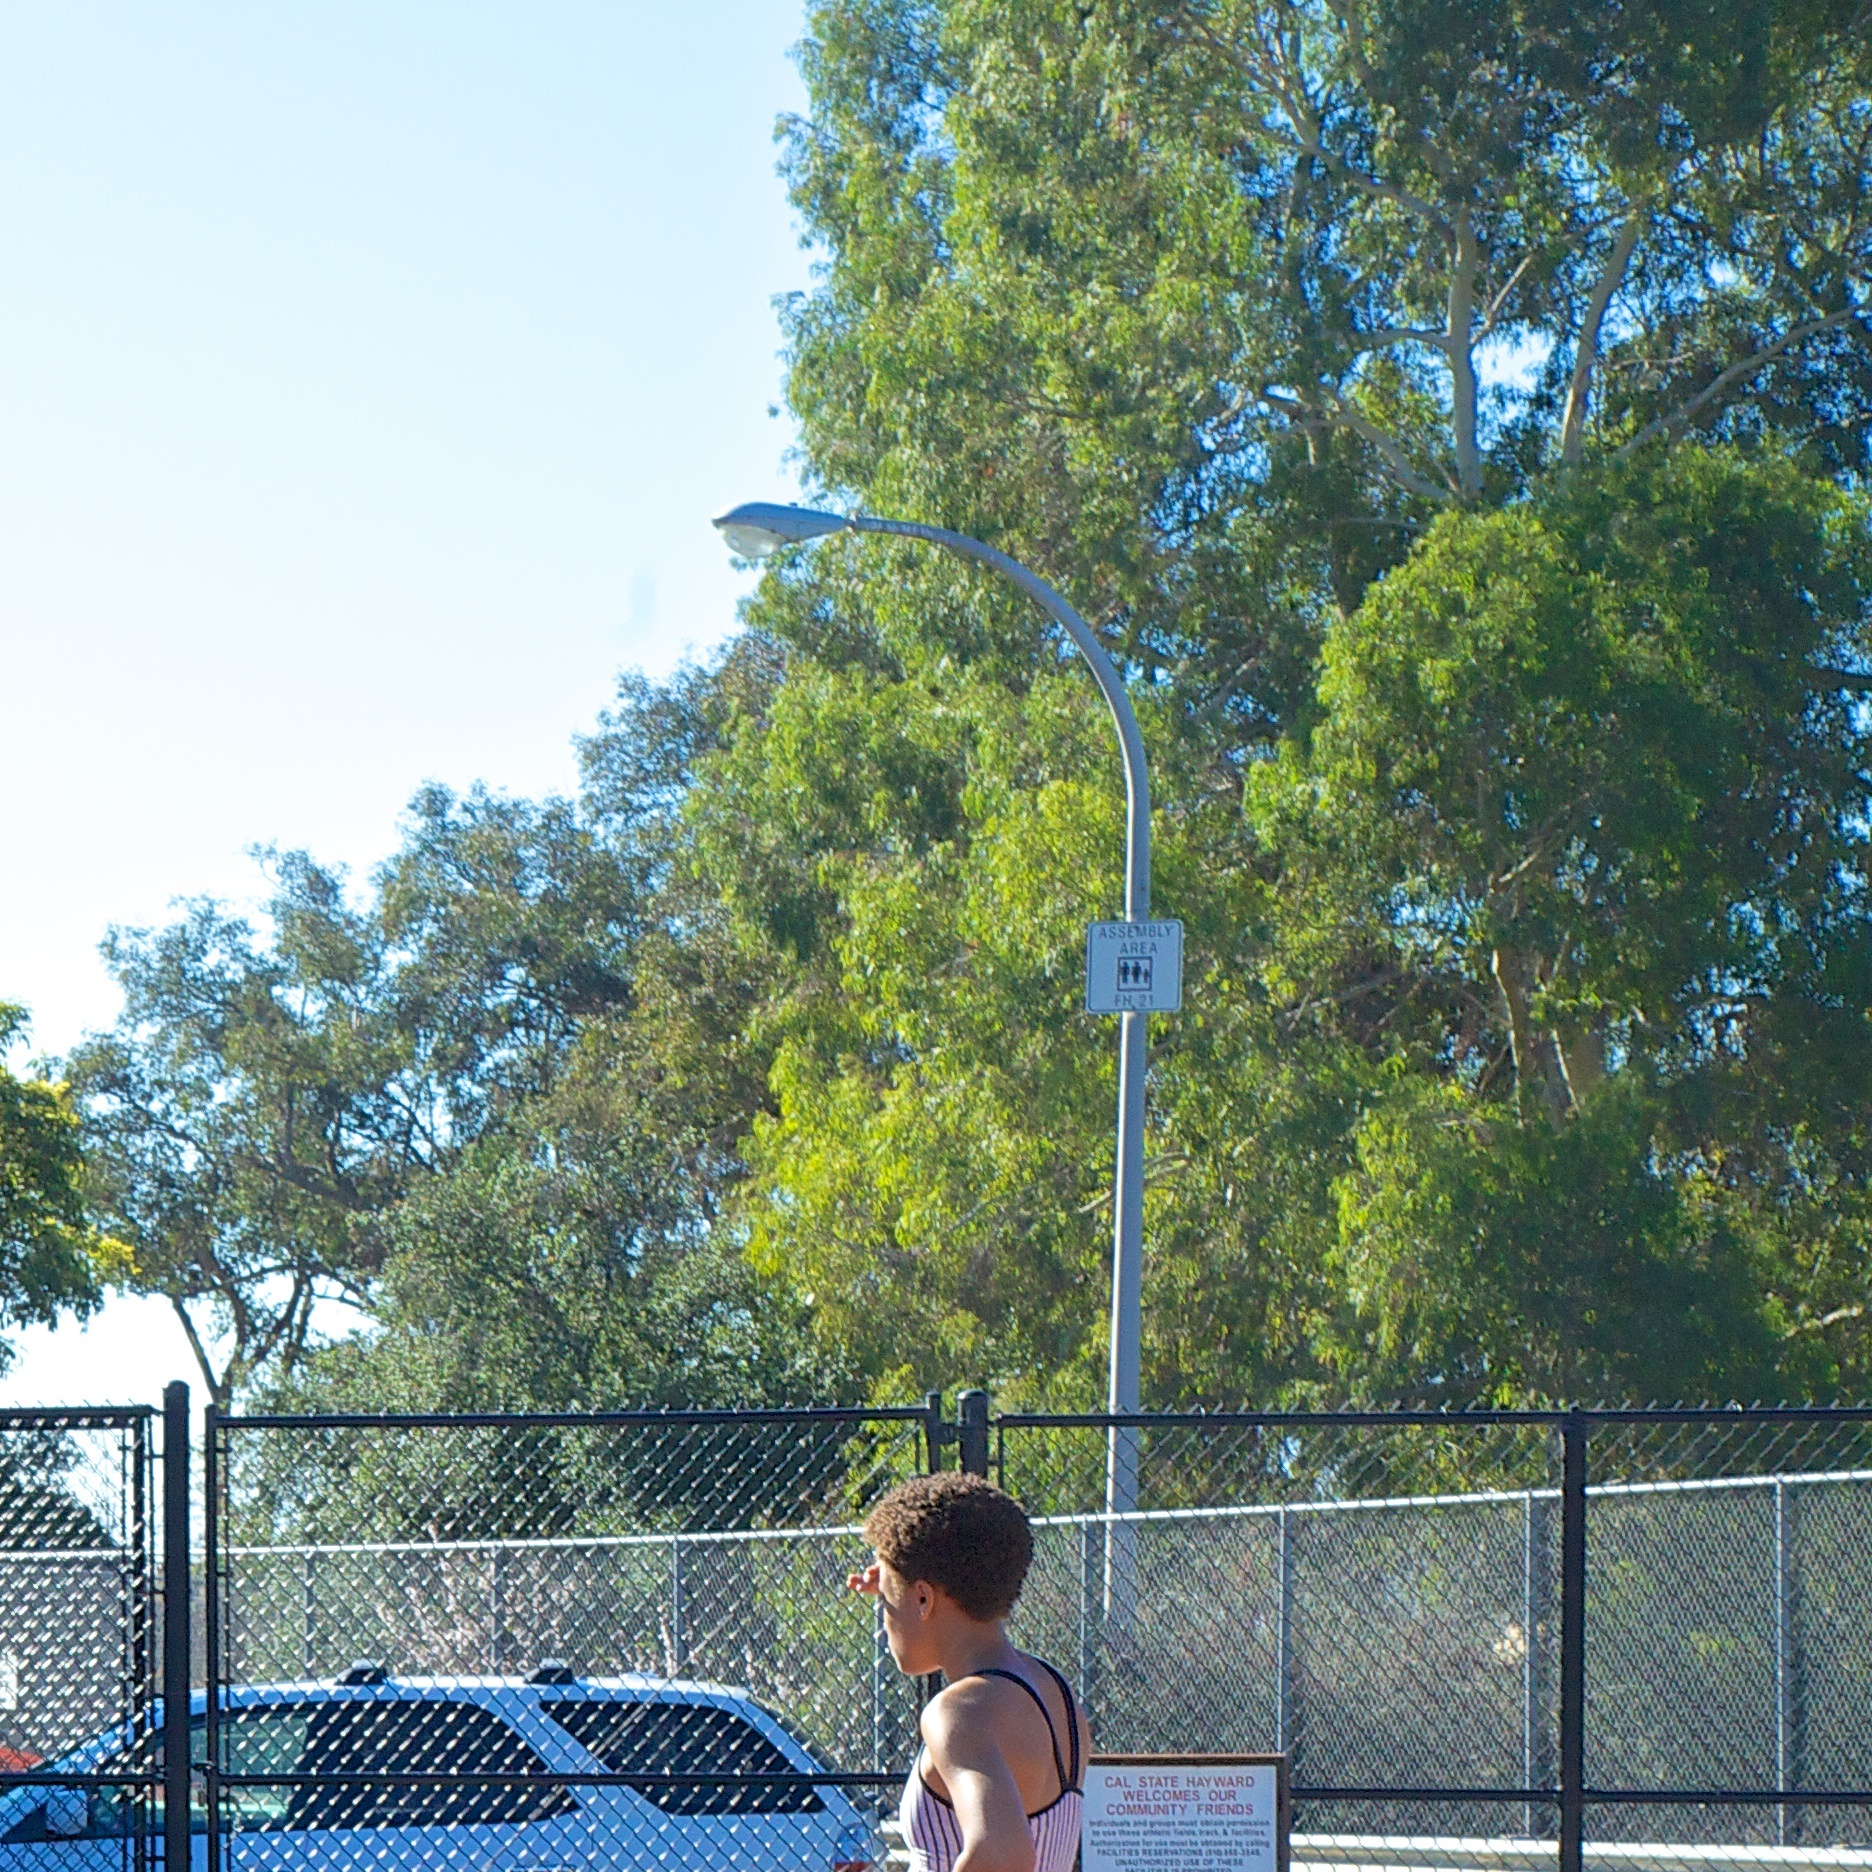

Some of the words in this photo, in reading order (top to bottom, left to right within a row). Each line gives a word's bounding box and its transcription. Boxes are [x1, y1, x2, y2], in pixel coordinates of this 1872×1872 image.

[1098, 924, 1174, 939] ASSEMBLY
[1119, 941, 1158, 954] AREA
[1104, 1776, 1131, 1788] CAL
[1138, 1776, 1179, 1788] STATE
[1186, 1776, 1255, 1788] HAYWARD
[1122, 1790, 1201, 1802] WELCOMES
[1208, 1790, 1237, 1802] OUR
[1106, 1803, 1187, 1816] COMMUNITY
[1196, 1803, 1254, 1816] FRIENDS
